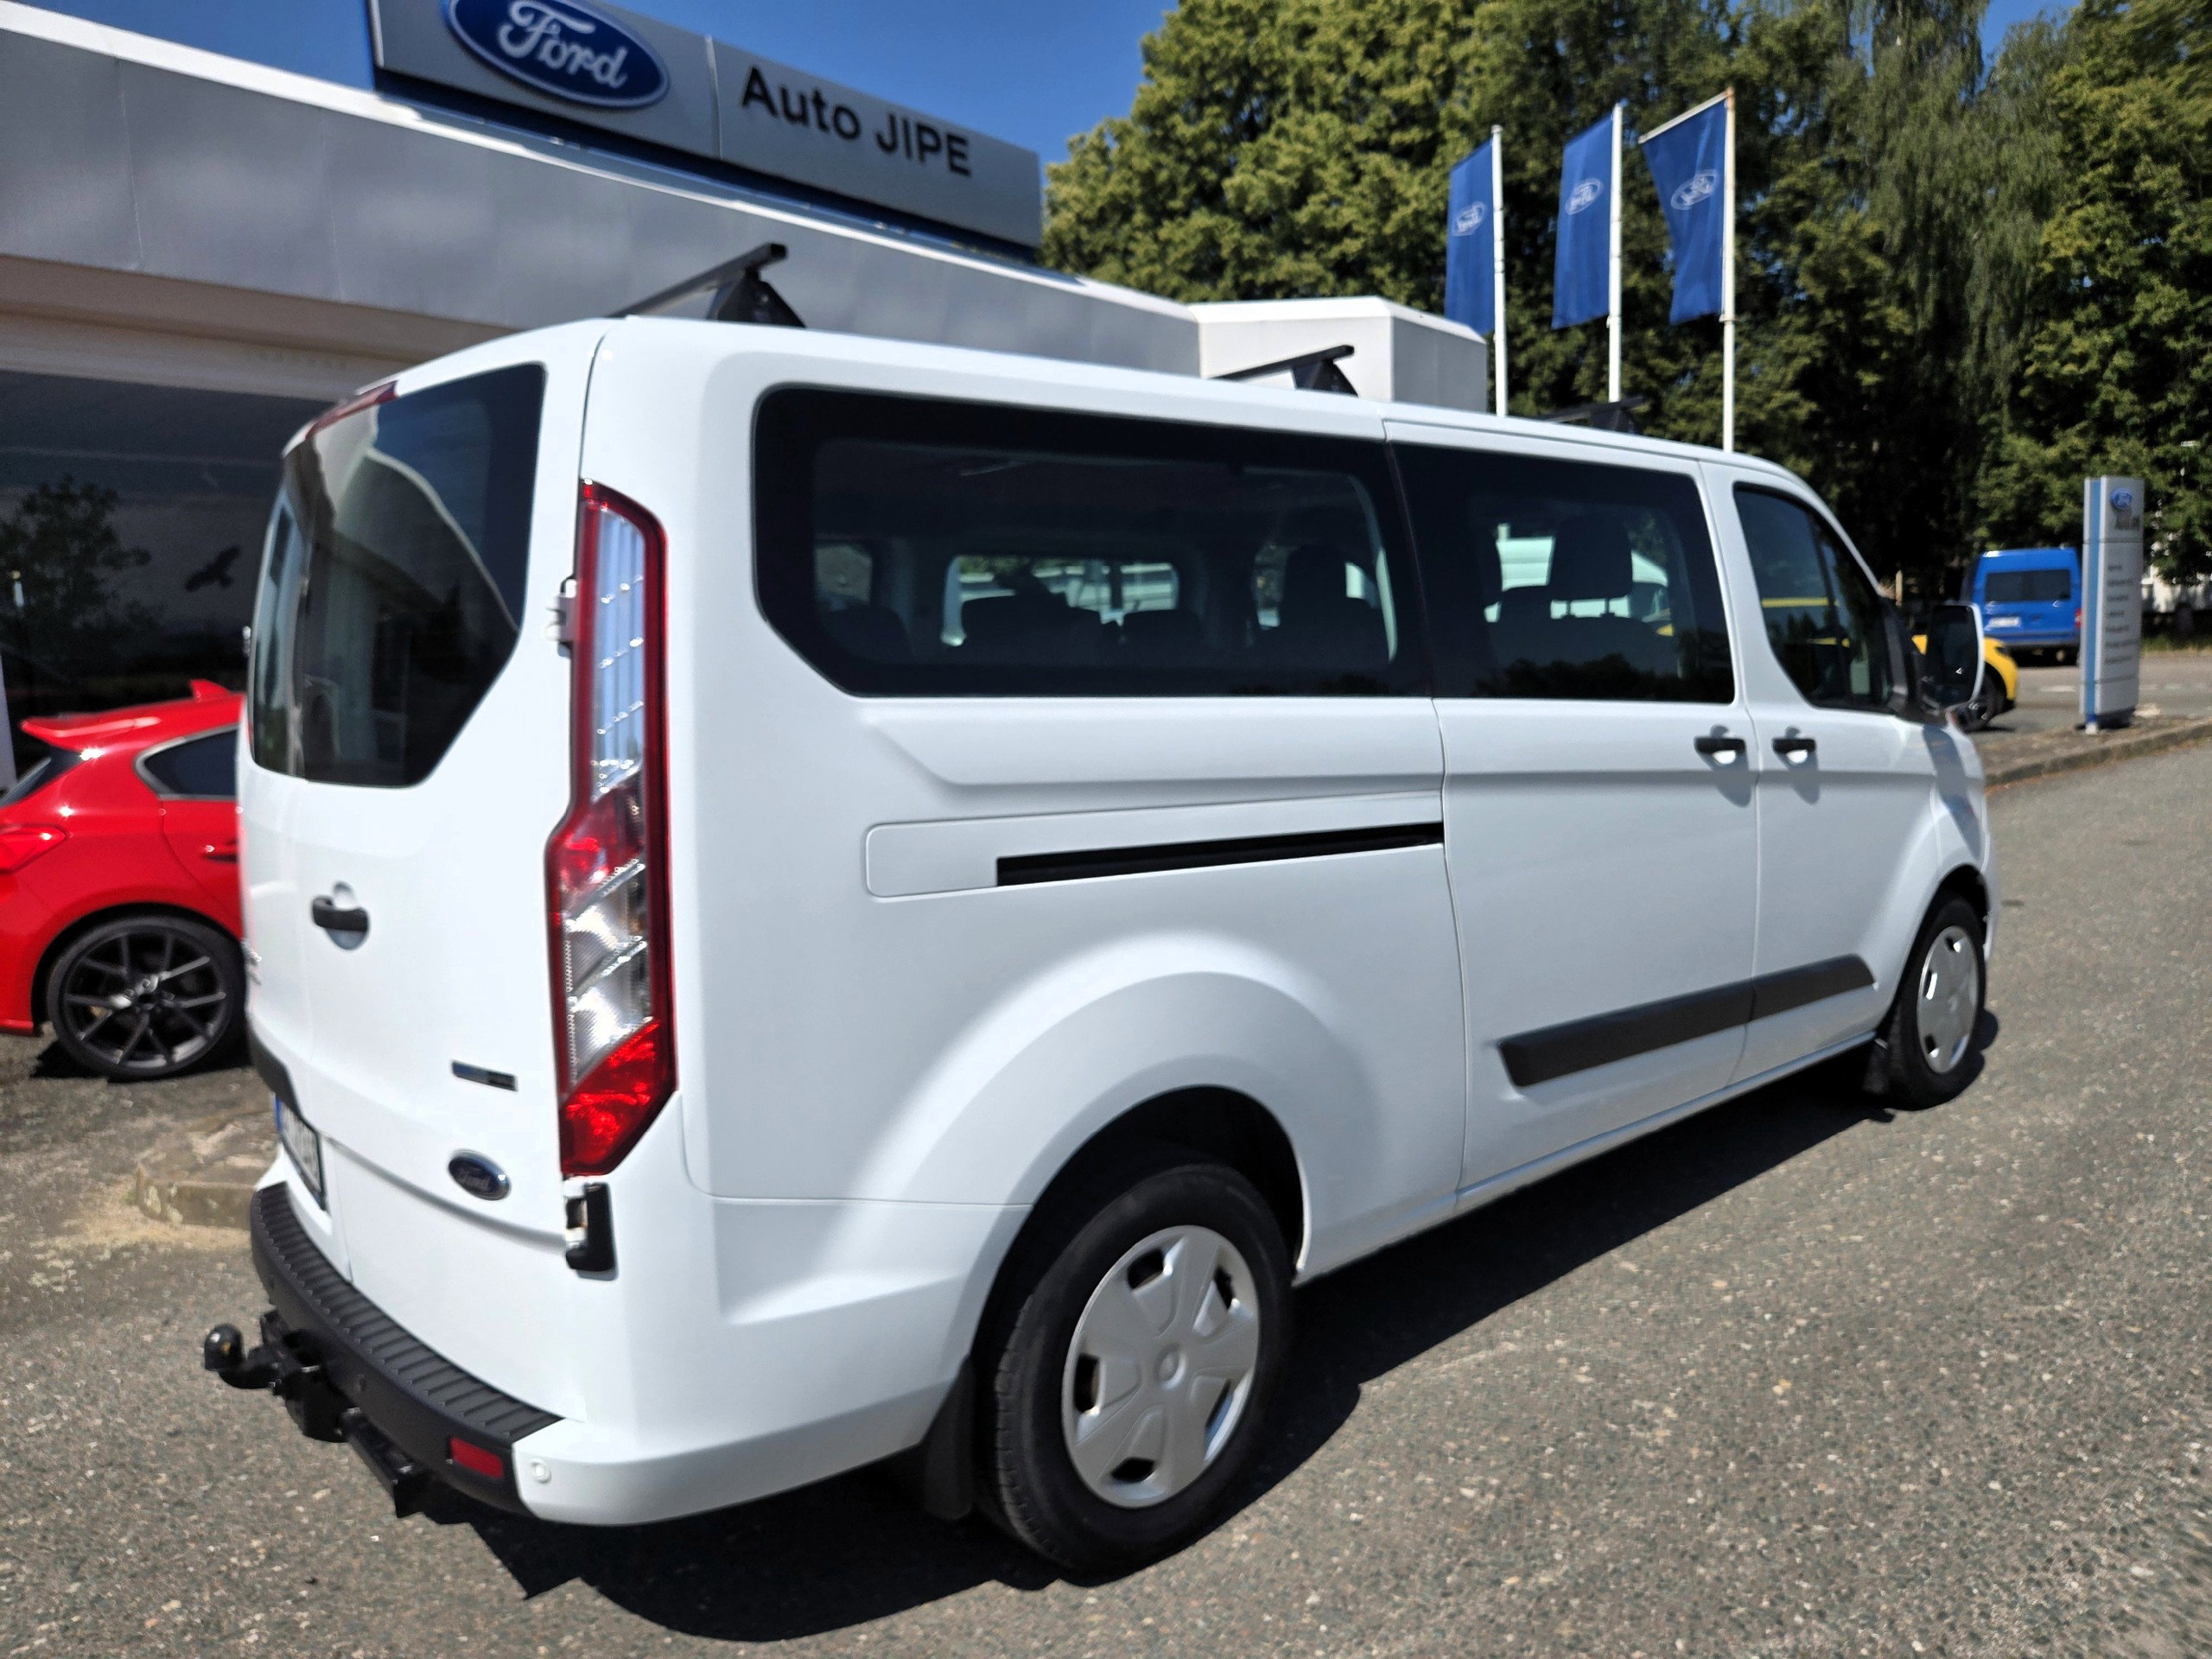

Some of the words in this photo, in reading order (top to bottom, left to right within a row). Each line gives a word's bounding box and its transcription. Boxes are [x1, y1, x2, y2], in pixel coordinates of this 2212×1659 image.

[498, 0, 628, 88] Ford
[741, 66, 861, 140] Auto
[875, 111, 971, 176] JIPE
